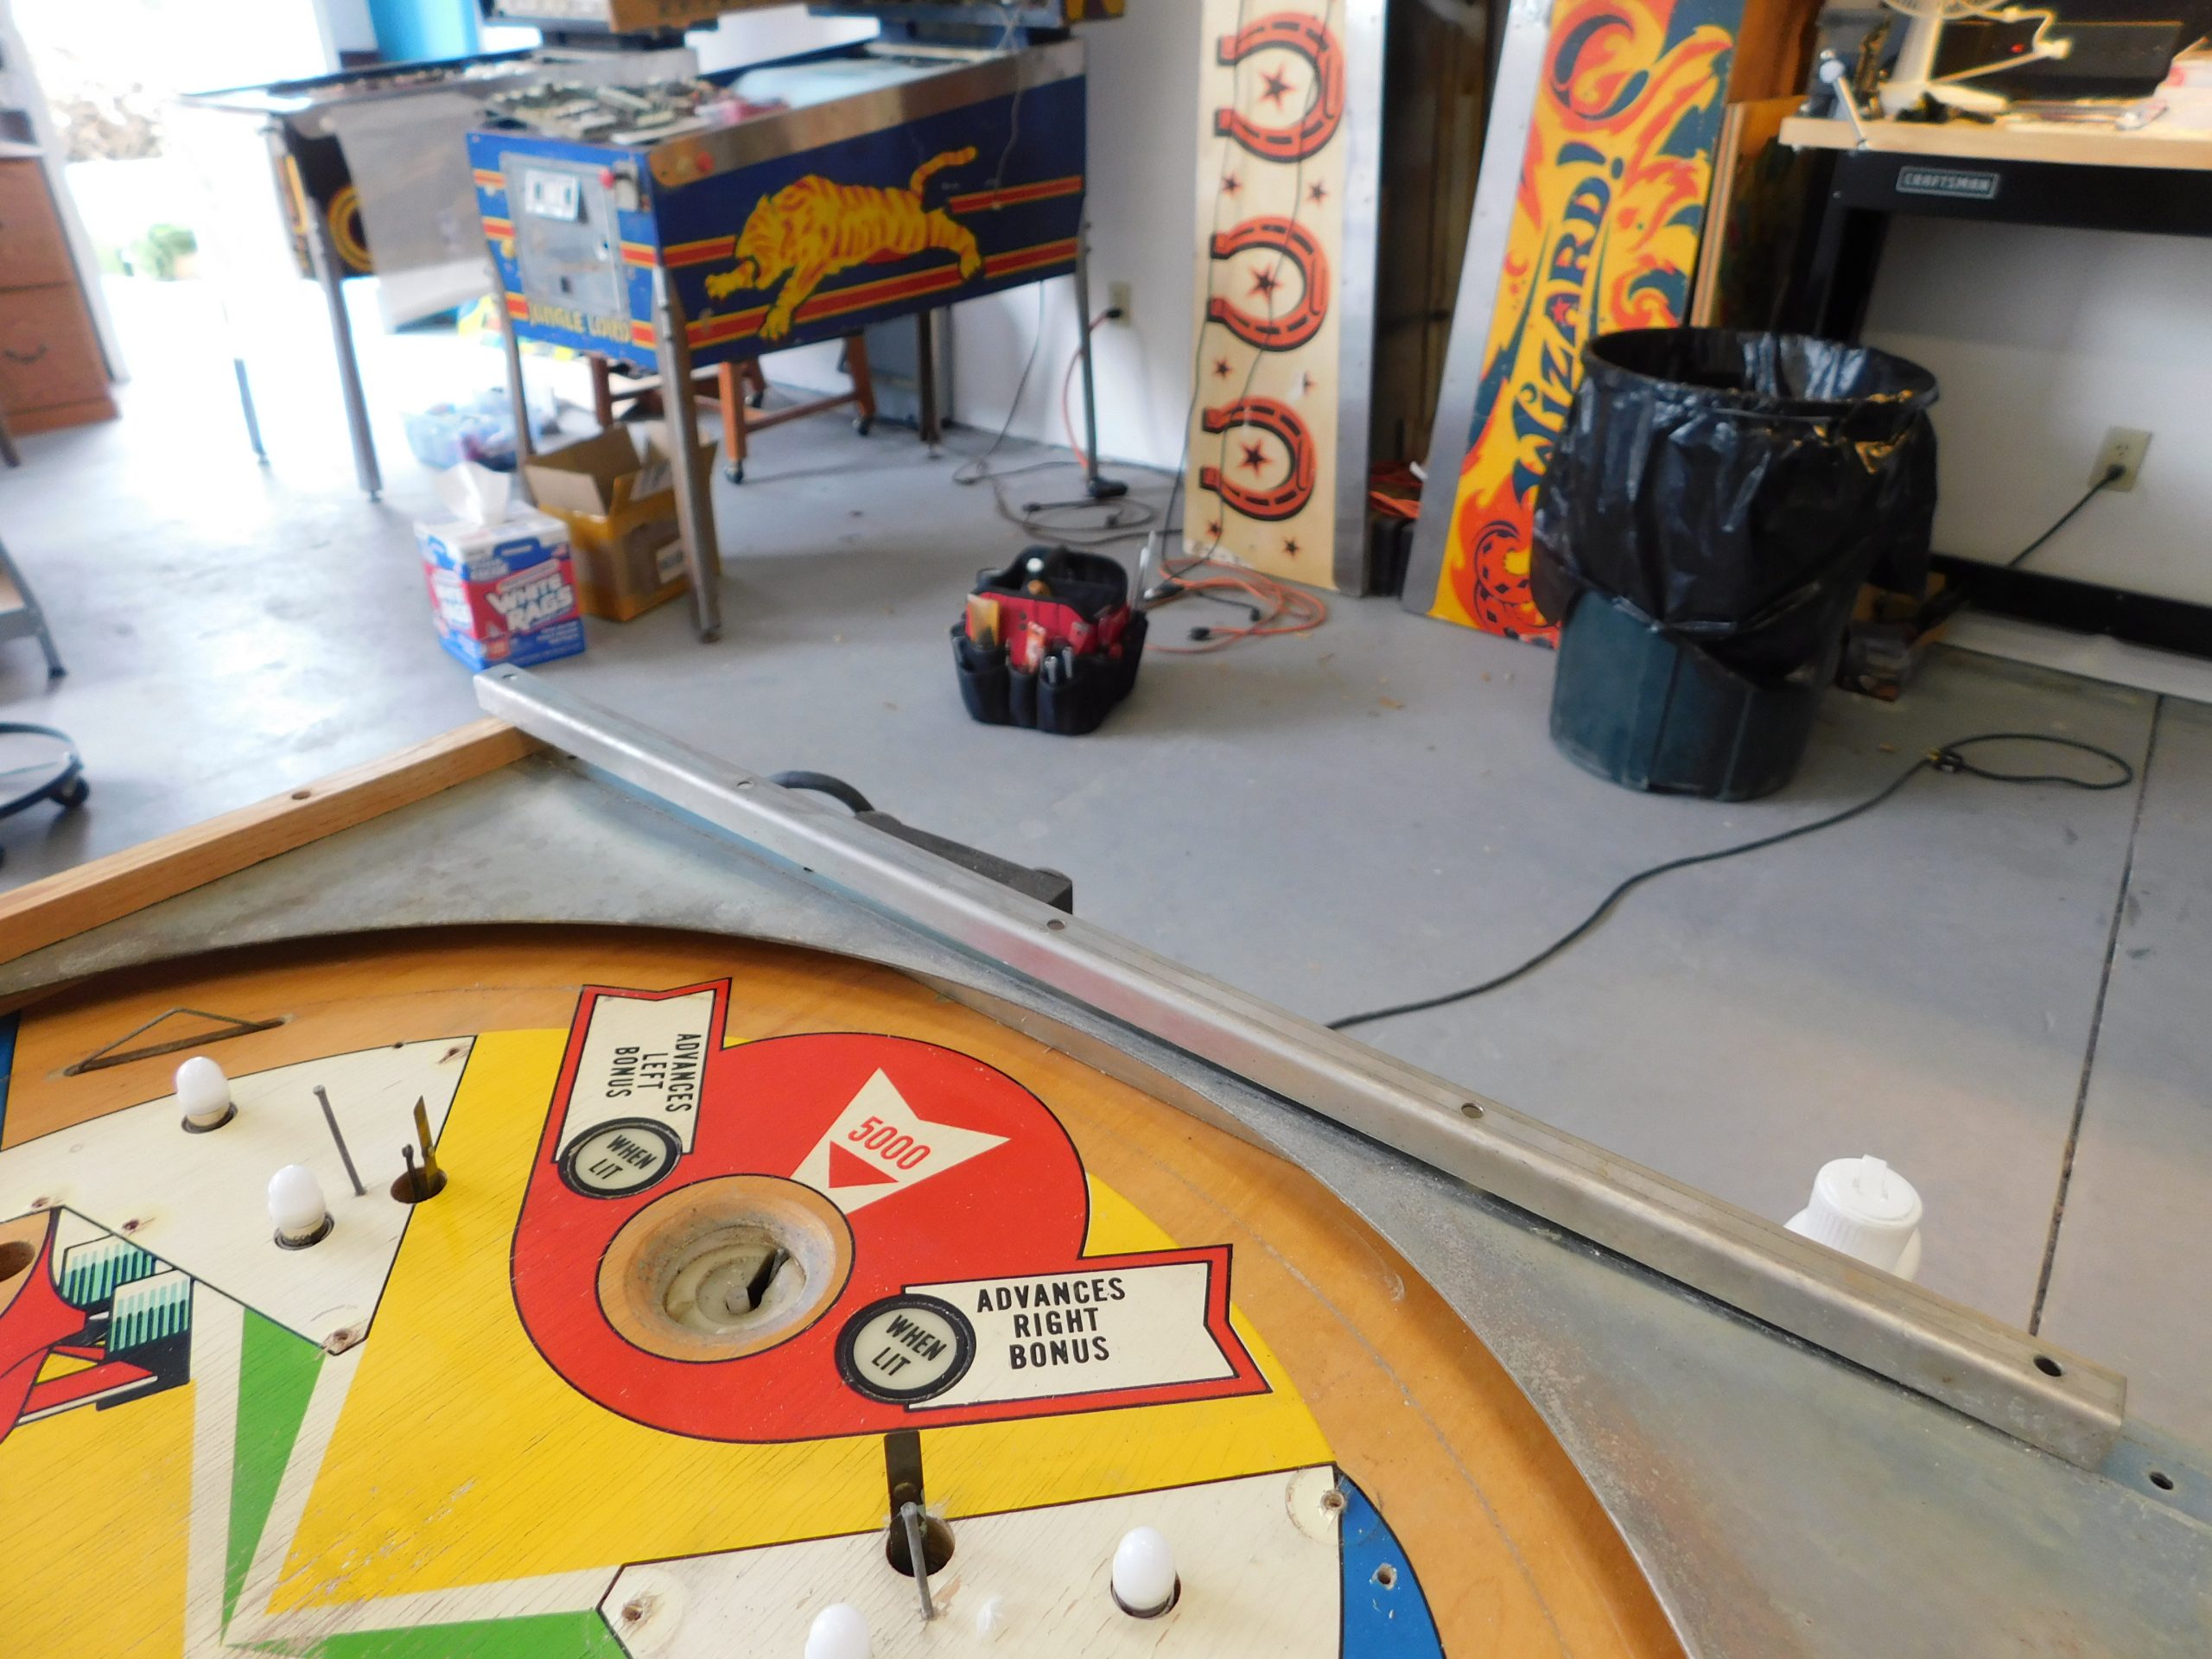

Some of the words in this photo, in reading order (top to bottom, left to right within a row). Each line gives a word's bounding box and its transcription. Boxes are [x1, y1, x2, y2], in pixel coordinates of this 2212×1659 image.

[1904, 172, 1991, 193] CRAFTSMAN
[530, 303, 584, 334] JUNGLE
[484, 572, 563, 616] WHITE
[506, 584, 574, 632] RAGS
[605, 1046, 640, 1098] BONUS
[637, 1052, 669, 1090] LEFT
[665, 1033, 702, 1112] ADVANCES
[606, 1135, 658, 1170] WHEN
[848, 1116, 931, 1170] 5000
[588, 1159, 624, 1180] LIT
[976, 1277, 1126, 1313] ADVANCES
[886, 1314, 948, 1362] WHEN
[1013, 1307, 1099, 1338] RIGHT
[871, 1346, 912, 1376] LIT
[1008, 1336, 1110, 1370] BONUS
